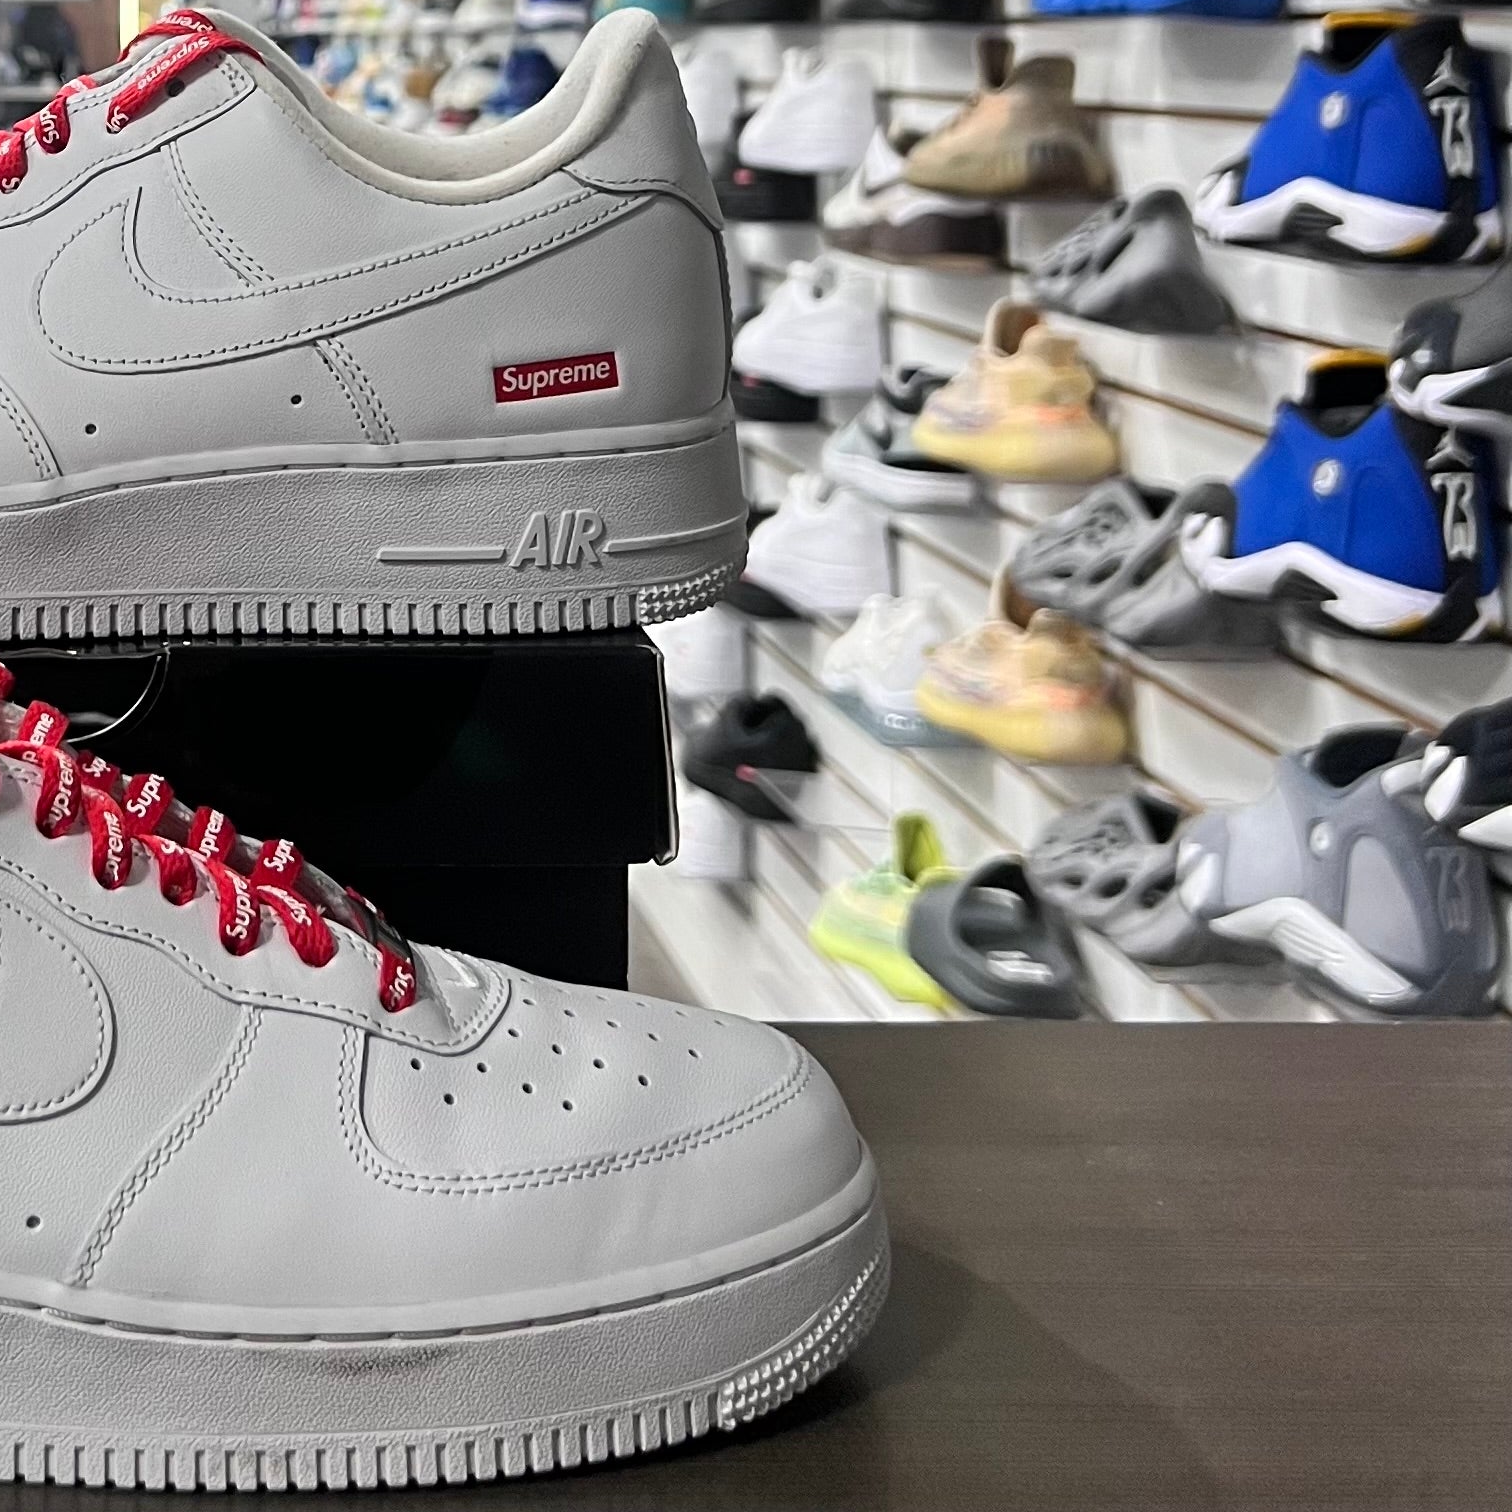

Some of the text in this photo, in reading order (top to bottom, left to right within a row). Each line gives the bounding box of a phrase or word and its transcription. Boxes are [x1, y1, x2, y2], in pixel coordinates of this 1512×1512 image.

[139, 36, 210, 91] Supreme
[501, 358, 610, 395] Supreme
[509, 507, 606, 569] AIR
